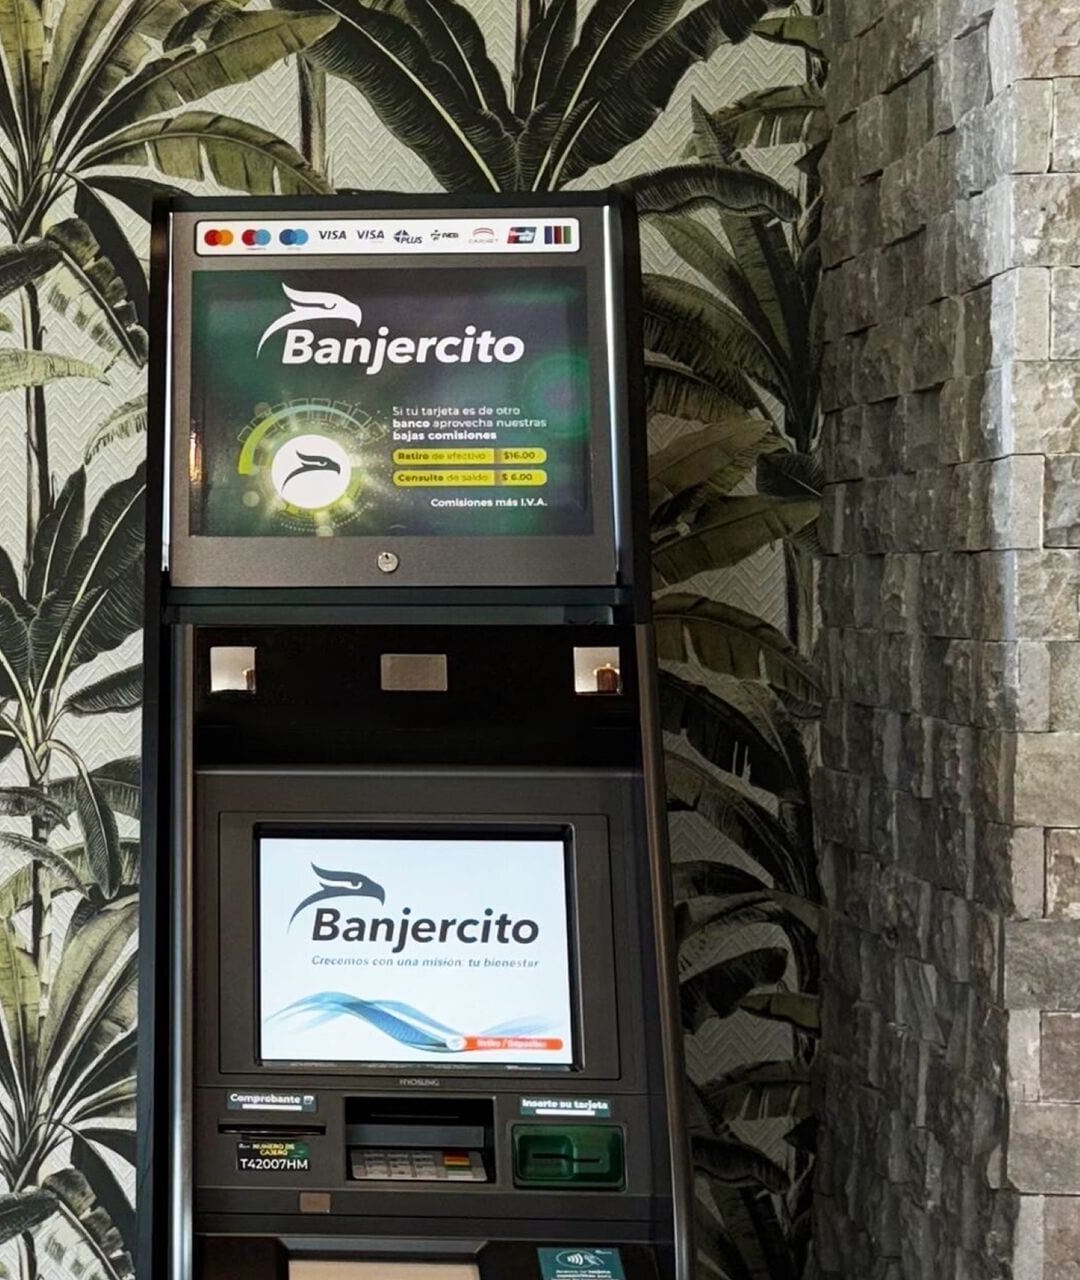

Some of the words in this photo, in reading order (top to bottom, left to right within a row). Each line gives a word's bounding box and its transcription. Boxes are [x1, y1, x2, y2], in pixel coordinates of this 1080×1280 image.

[318, 230, 347, 240] VISA
[357, 230, 385, 240] VISA
[400, 236, 423, 244] PLUS
[282, 325, 525, 375] Banjercito
[392, 406, 403, 416] Si
[406, 406, 418, 416] tu
[421, 406, 459, 418] tarjeta
[462, 407, 476, 415] es
[478, 405, 493, 416] de
[496, 406, 521, 416] otro
[392, 418, 431, 428] banco
[432, 418, 494, 429] aprovecha
[496, 419, 547, 428] nuestras
[392, 430, 425, 442] bajas
[427, 430, 497, 441] comisiones
[398, 452, 429, 461] Retiro
[432, 452, 445, 461] de
[447, 451, 486, 461] efectivo
[504, 451, 536, 461] $16.00
[398, 473, 444, 483] Consulta
[446, 473, 459, 483] de
[461, 473, 489, 483] saldo
[430, 498, 494, 508] Comisiones
[495, 498, 519, 507] más
[520, 497, 548, 507] I.V.A.
[312, 907, 540, 954] Banjercito
[311, 955, 369, 967] Crecemos
[372, 958, 394, 968] con
[397, 958, 419, 968] una
[469, 957, 481, 968] tu
[484, 957, 539, 969] bienestar
[230, 1093, 301, 1104] Comprobante
[522, 1098, 558, 1108] Inserte
[559, 1100, 572, 1109] su
[574, 1099, 608, 1111] tarjeta
[240, 1158, 308, 1170] T42007HM
